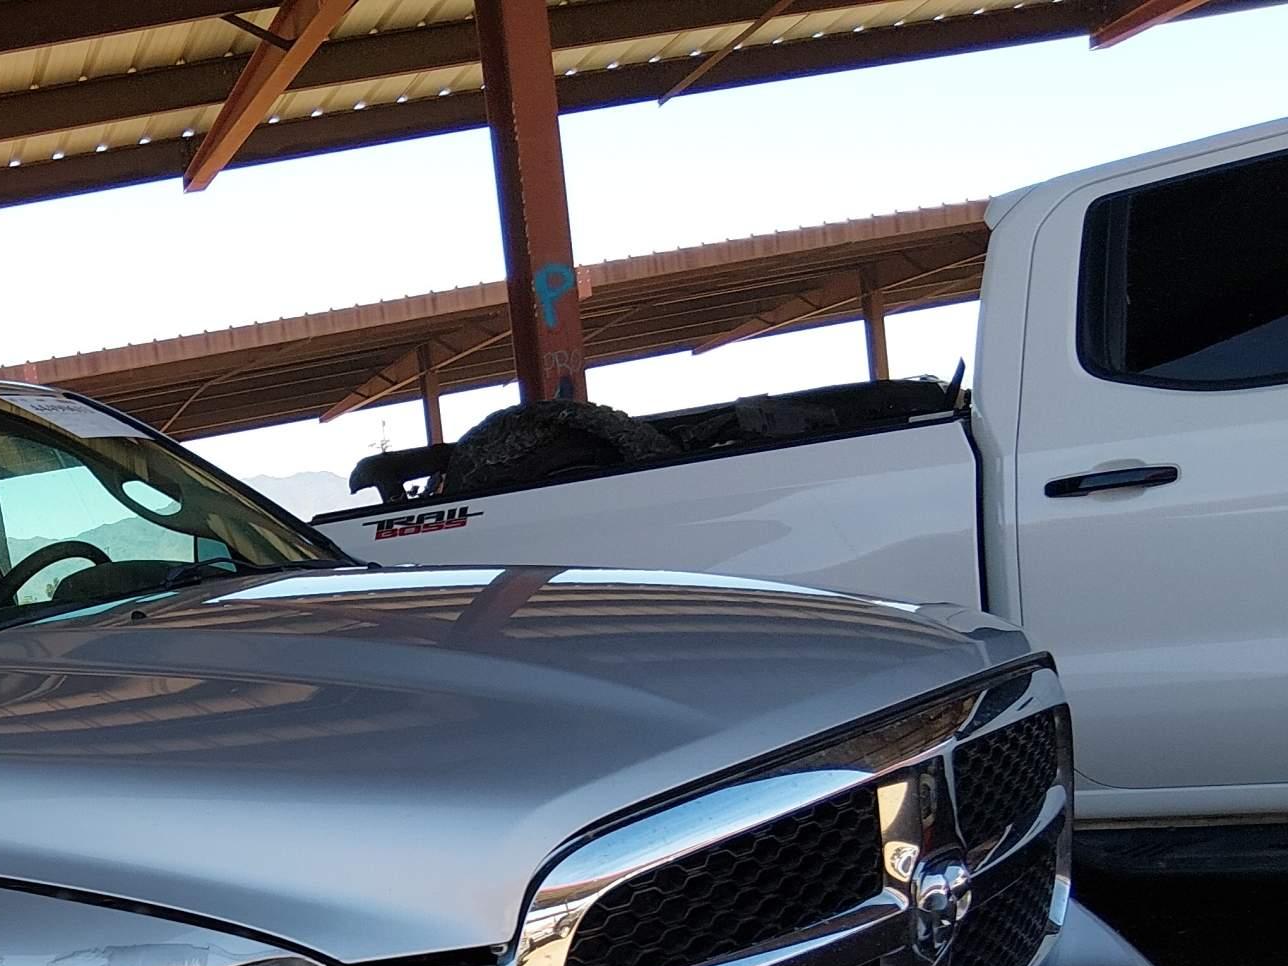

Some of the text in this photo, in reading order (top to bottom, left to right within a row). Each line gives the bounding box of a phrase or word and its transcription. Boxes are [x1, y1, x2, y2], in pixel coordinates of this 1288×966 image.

[534, 263, 575, 329] P
[362, 506, 484, 531] TRAIL
[375, 519, 468, 541] BOSS
